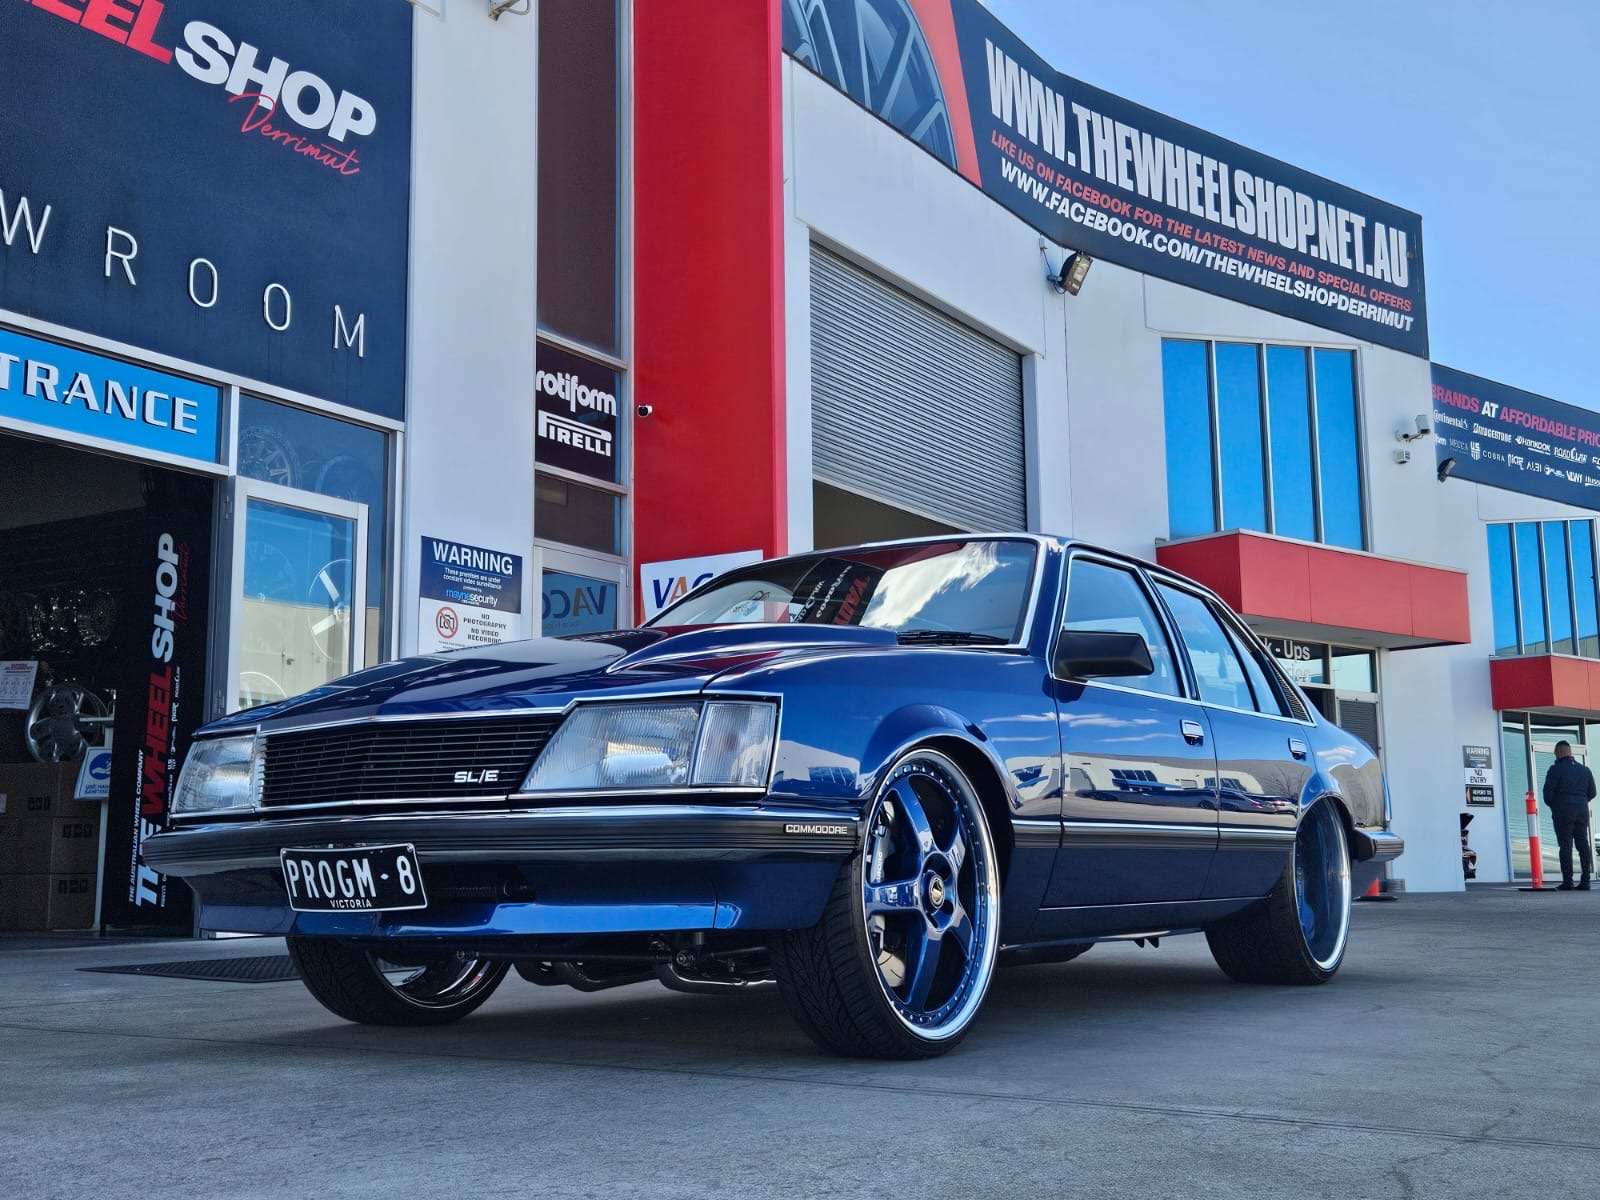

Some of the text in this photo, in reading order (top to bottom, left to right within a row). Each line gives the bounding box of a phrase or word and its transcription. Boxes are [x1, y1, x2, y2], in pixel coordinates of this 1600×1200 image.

[175, 21, 376, 142] SHOP
[228, 93, 360, 175] Derrimut
[991, 129, 1412, 312] LIKE US ON FACEBOOK FOR THE LATEST NEWS AND SPECIAL OFFERS
[1001, 158, 1414, 332] WWW.FACEBOOK.COM/THEWHEELSHOPDERRIMUT
[536, 370, 617, 416] rotiform
[538, 410, 612, 457] PIRELLI
[1481, 401, 1499, 418] AT
[1500, 407, 1576, 441] AFFORDABLE
[1483, 449, 1505, 462] COBRA
[433, 541, 512, 575] WARNING
[152, 532, 179, 662] SHOP
[463, 618, 506, 630] PHOTOGRAPHY
[1284, 640, 1310, 661] Ups
[142, 666, 171, 814] WHEEL
[453, 769, 499, 784] SL/E
[130, 828, 139, 884] AUSTRALIAN
[136, 750, 144, 795] COMPANY
[785, 824, 848, 834] COMMODORE
[330, 899, 372, 909] VICTORIA
